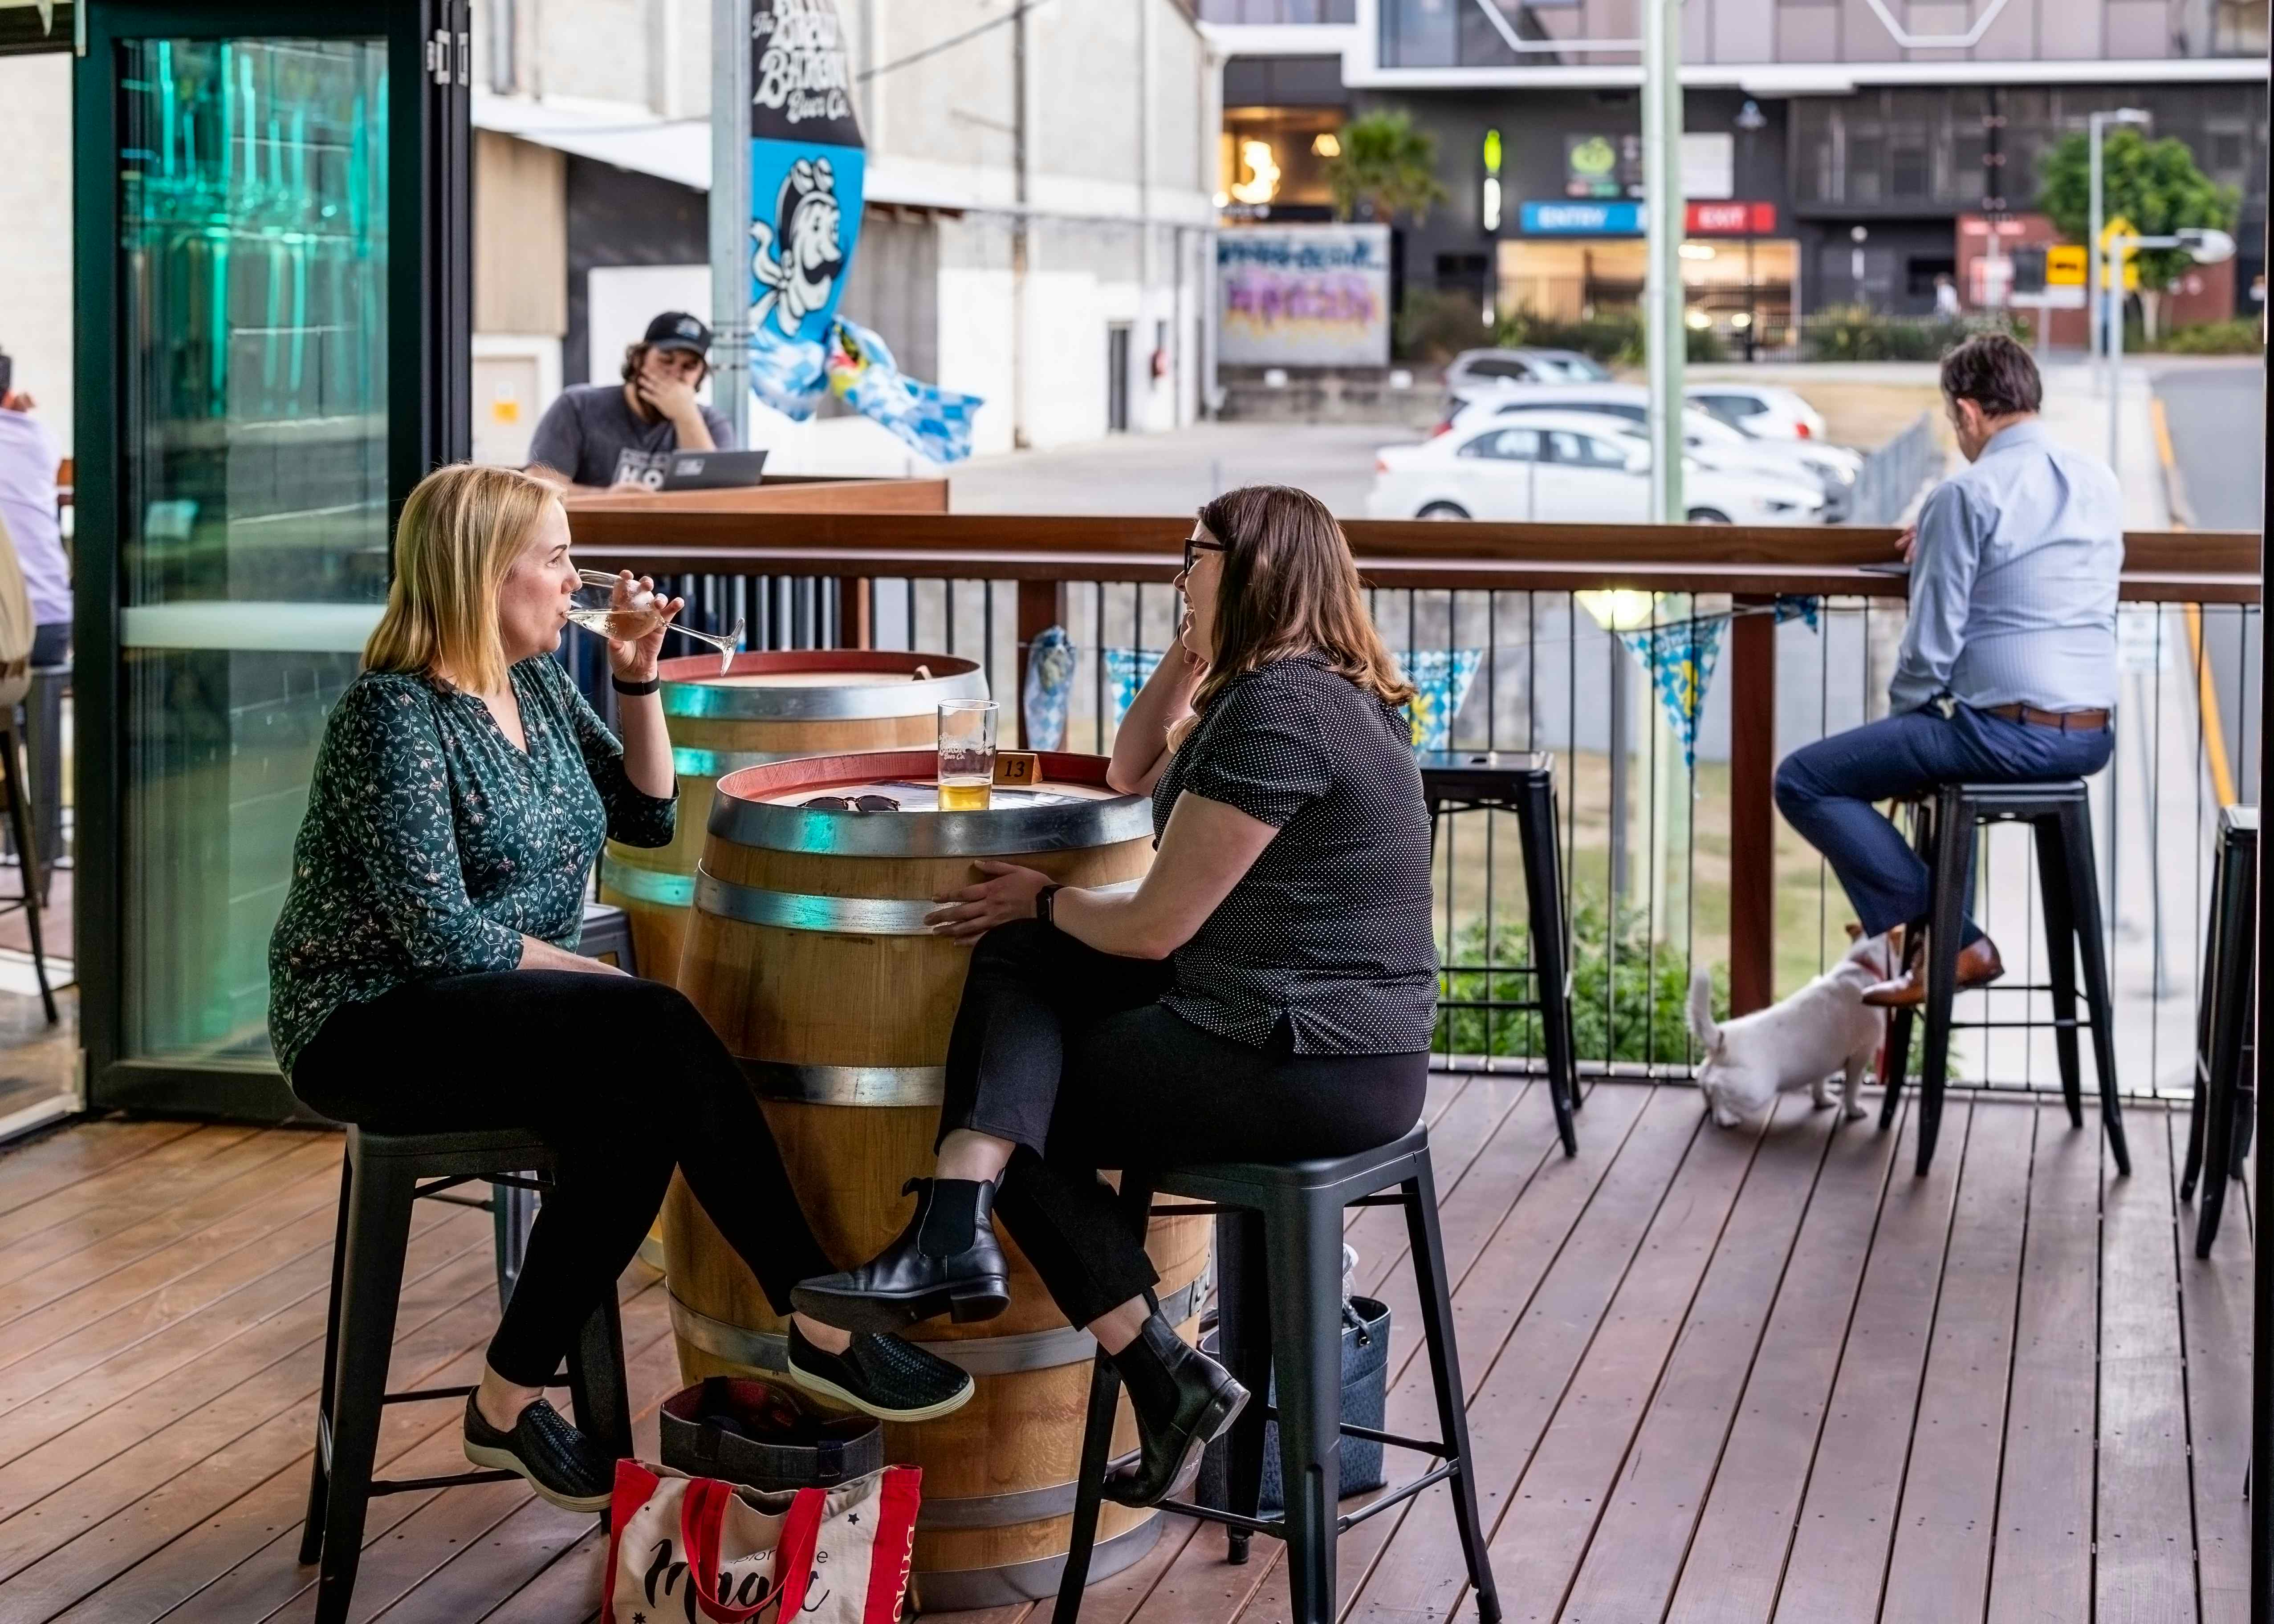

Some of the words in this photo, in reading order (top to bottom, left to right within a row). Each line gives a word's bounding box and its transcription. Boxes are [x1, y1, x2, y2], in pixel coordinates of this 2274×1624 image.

[1537, 205, 1607, 227] ENTRY
[1697, 205, 1747, 228] EXIT
[1005, 760, 1025, 777] 13
[893, 1524, 915, 1624] DYMO
